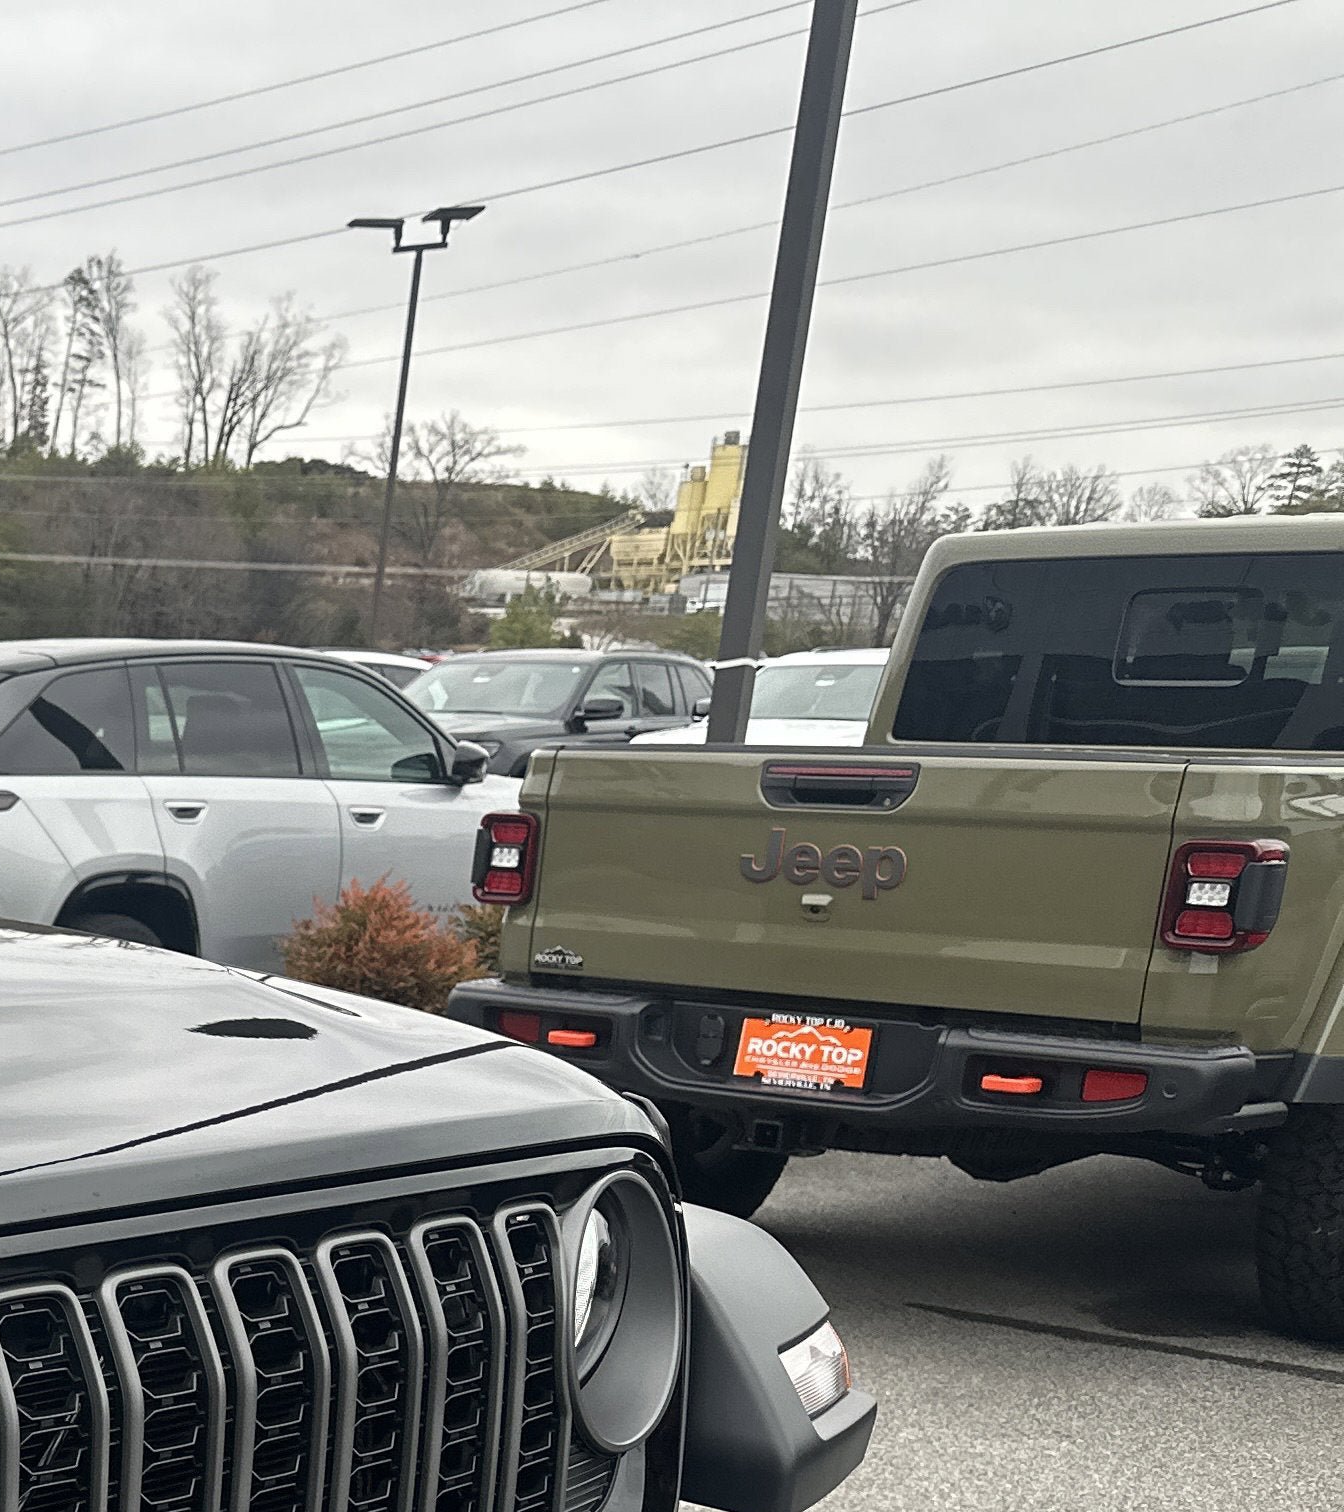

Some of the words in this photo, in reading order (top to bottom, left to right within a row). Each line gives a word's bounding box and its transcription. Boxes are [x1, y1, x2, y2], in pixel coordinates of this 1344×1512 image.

[740, 827, 908, 900] Jeep
[747, 1037, 817, 1060] ROCKY
[820, 1045, 864, 1065] TOP
